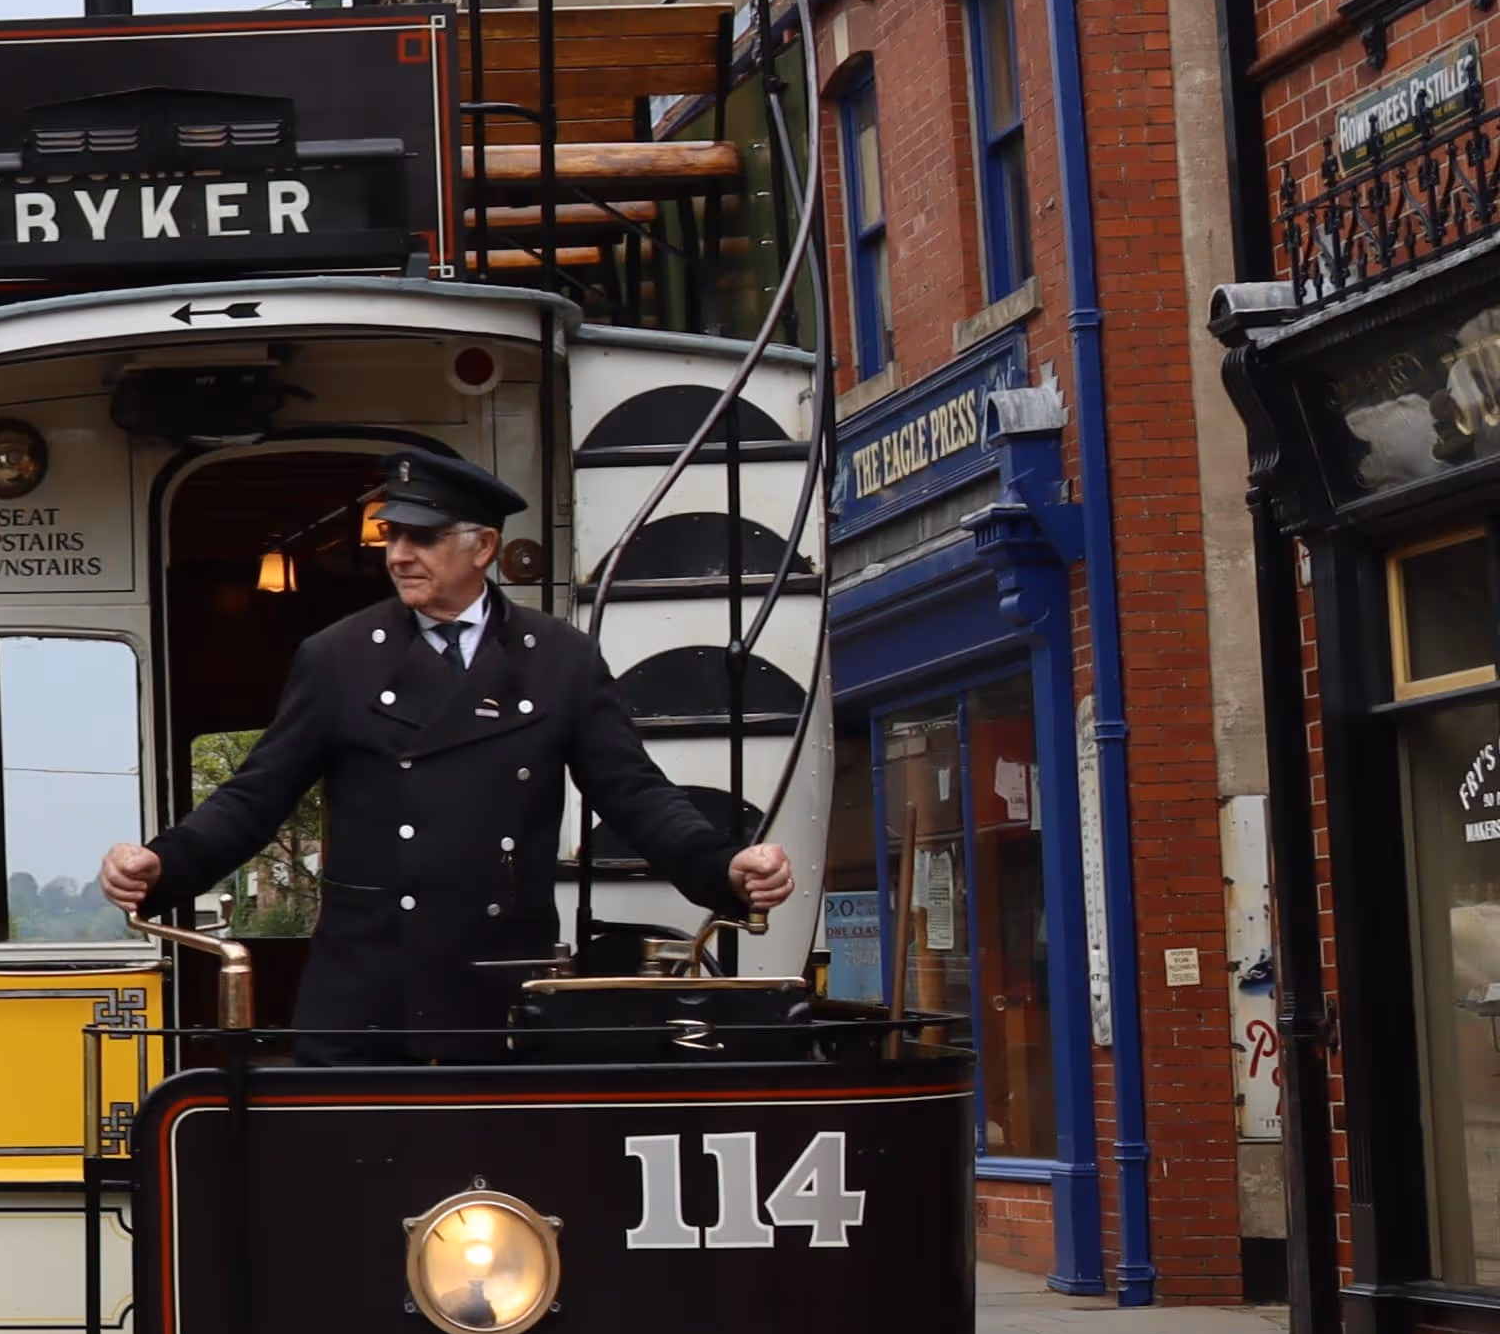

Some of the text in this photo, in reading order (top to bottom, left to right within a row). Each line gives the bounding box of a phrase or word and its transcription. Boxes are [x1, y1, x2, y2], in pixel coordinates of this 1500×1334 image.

[14, 179, 311, 244] BYKER
[852, 388, 978, 500] THE EAGLE PRESS
[1458, 744, 1496, 811] FRY'S
[625, 1131, 867, 1250] 114
